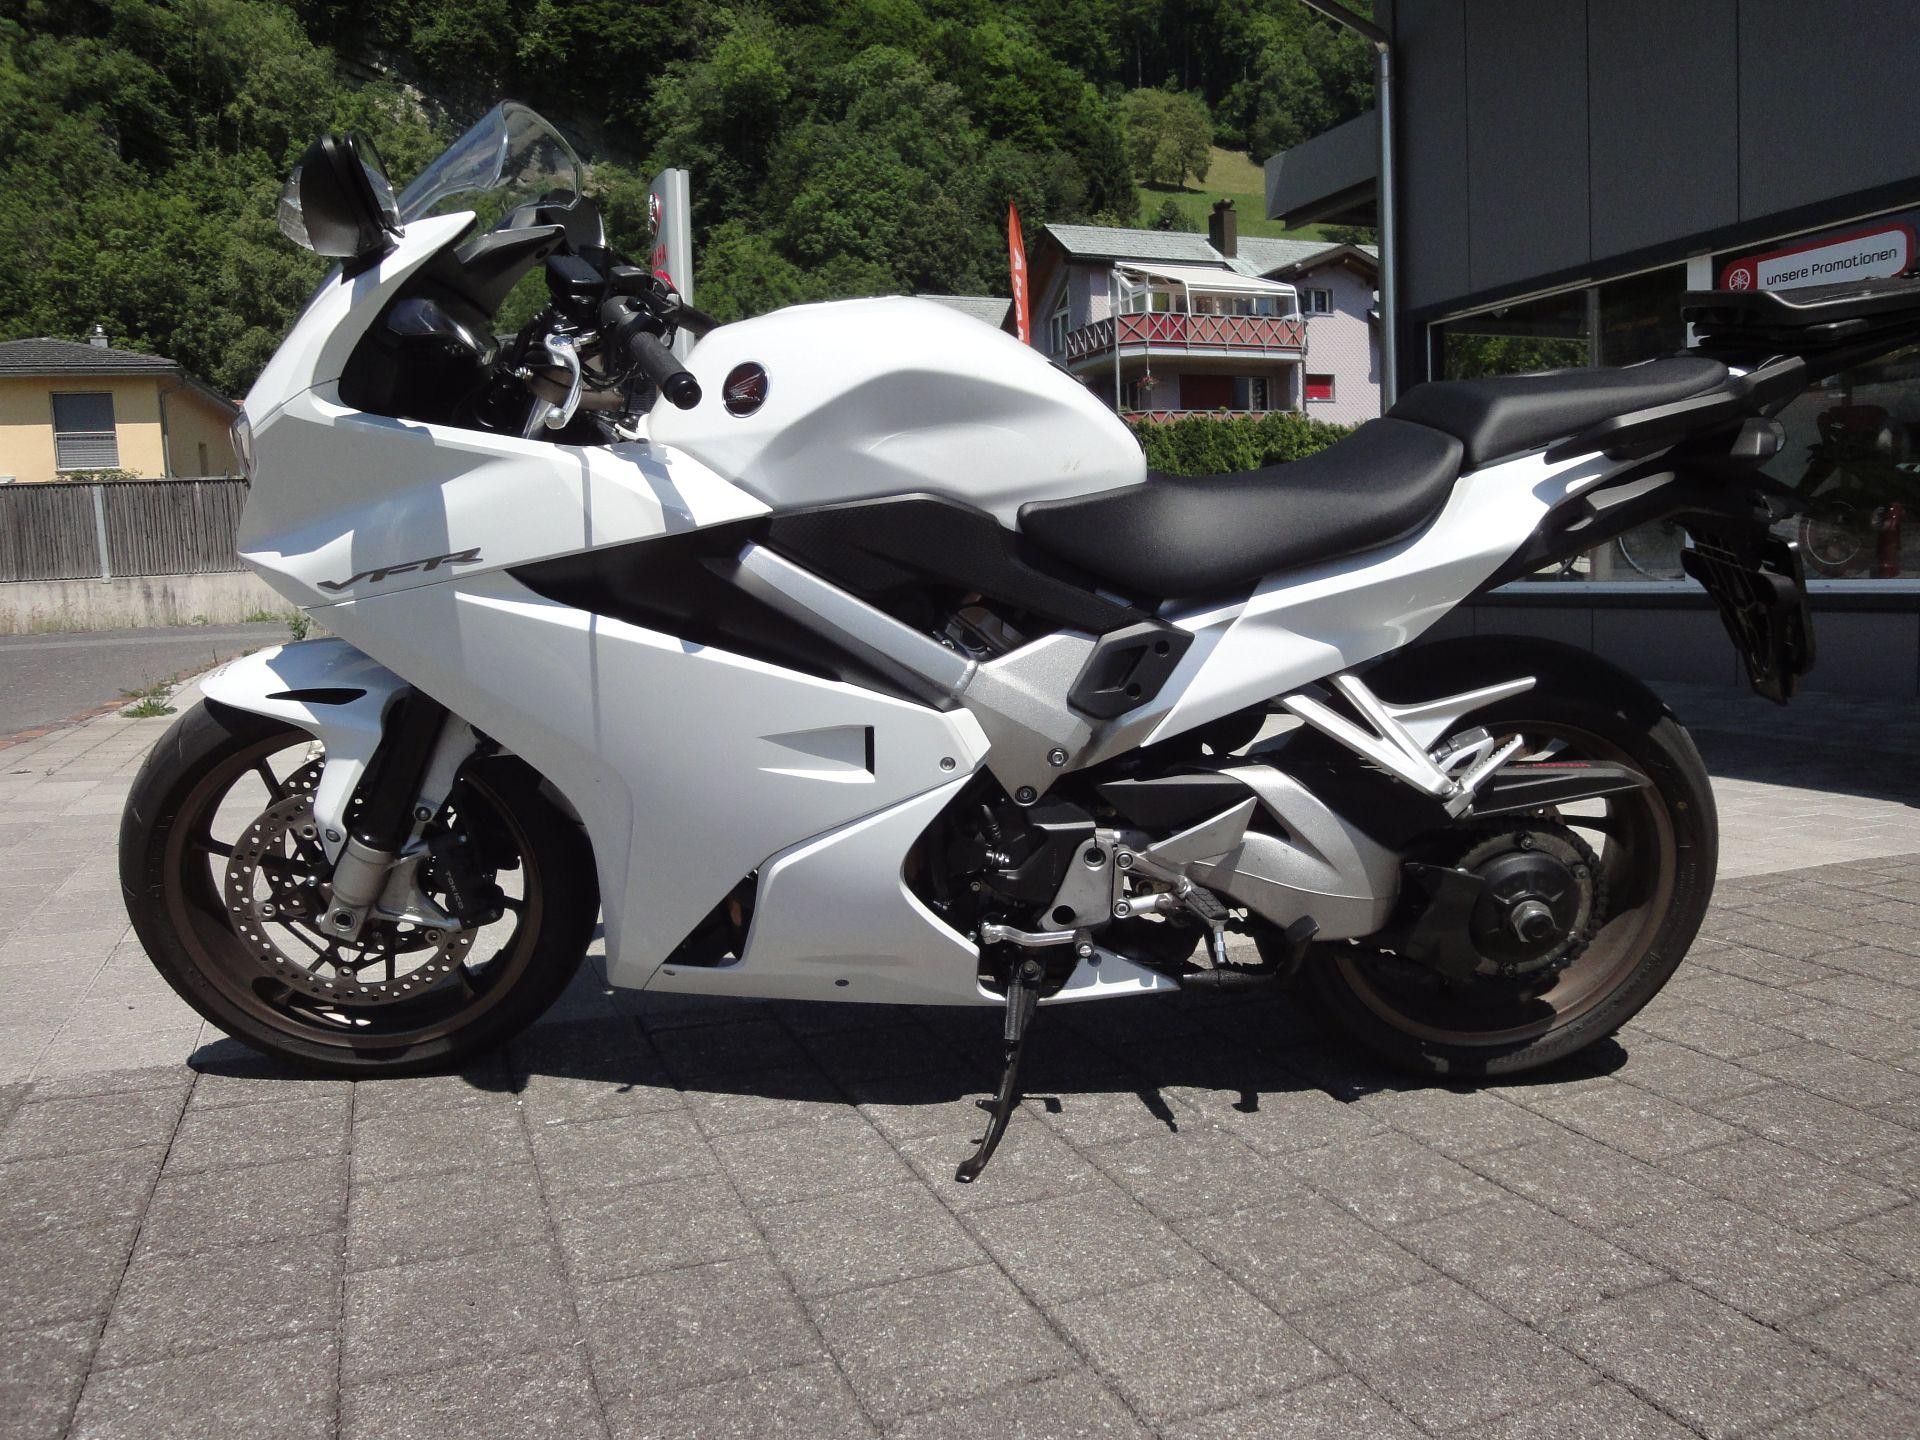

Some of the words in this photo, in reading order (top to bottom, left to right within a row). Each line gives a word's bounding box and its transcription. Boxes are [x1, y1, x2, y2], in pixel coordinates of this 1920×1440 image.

[1766, 267, 1809, 286] unsere
[1811, 248, 1897, 275] Promotionen
[445, 870, 464, 909] TOKICO
